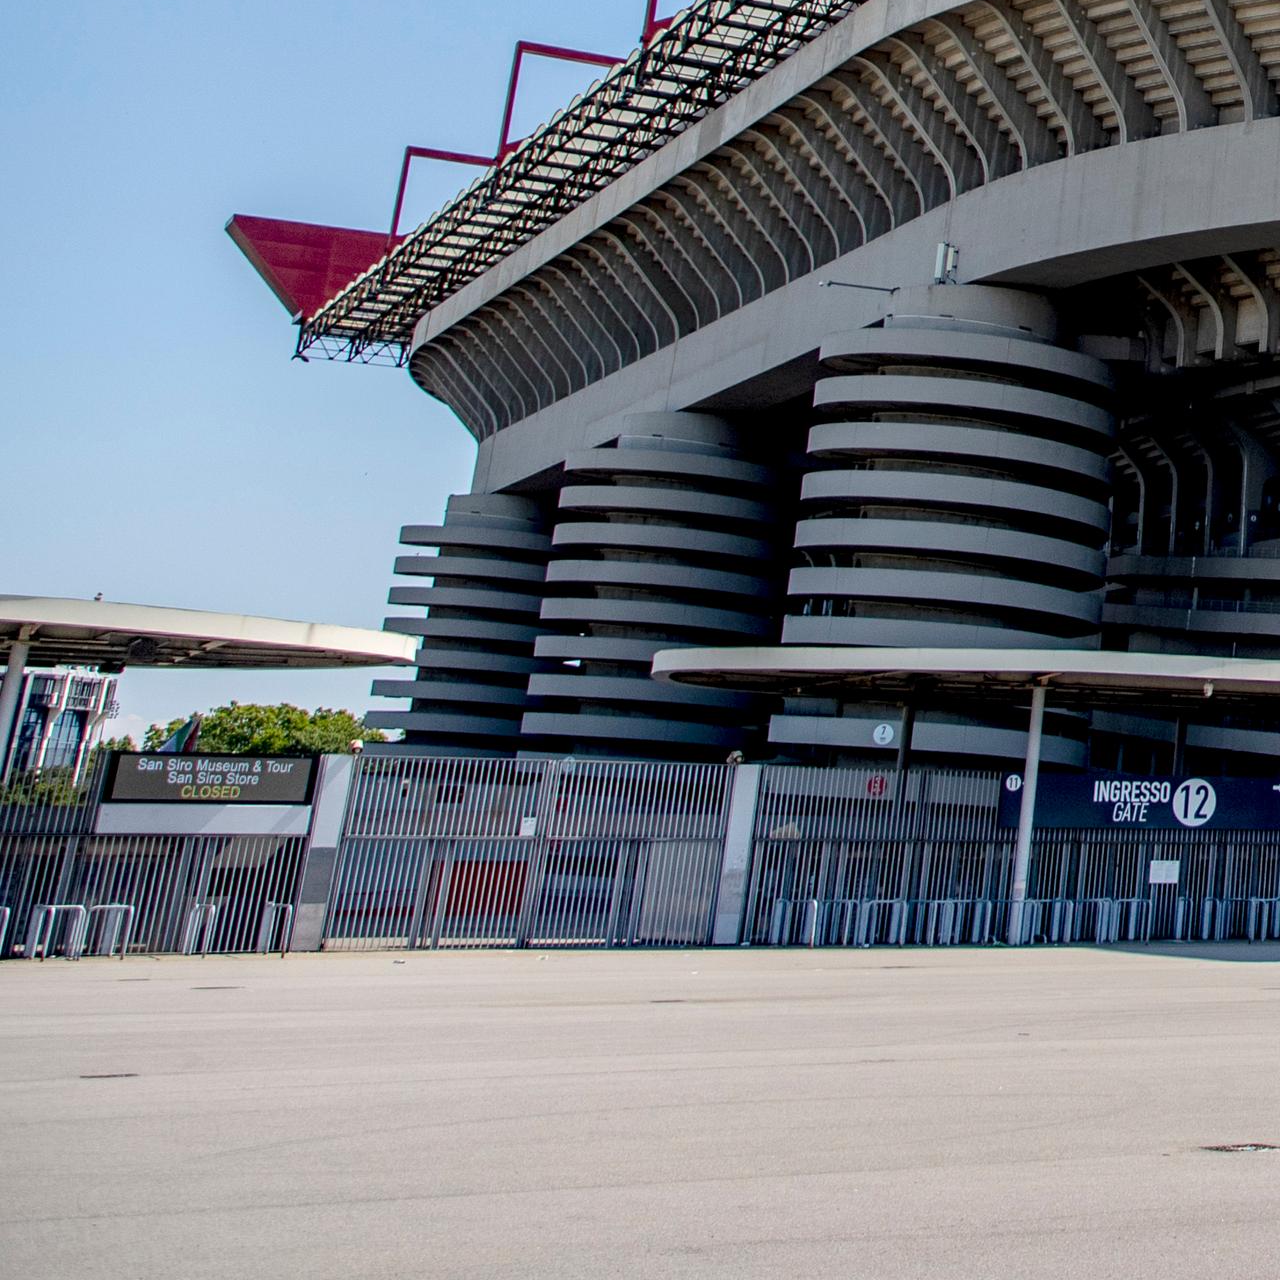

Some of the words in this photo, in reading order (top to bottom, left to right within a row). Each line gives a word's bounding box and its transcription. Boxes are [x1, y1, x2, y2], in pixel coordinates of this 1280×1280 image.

[137, 758, 163, 770] San
[167, 758, 193, 771] Siro
[196, 759, 251, 772] Museum
[252, 760, 262, 772] &
[266, 760, 294, 773] Tour
[167, 771, 193, 784] San
[196, 772, 222, 785] Siro
[226, 772, 259, 785] Store
[1009, 776, 1019, 789] 11
[181, 785, 241, 798] CLOSED
[1093, 780, 1171, 803] INGRESSO
[1179, 784, 1210, 820] 12
[1112, 802, 1150, 822] GATE
